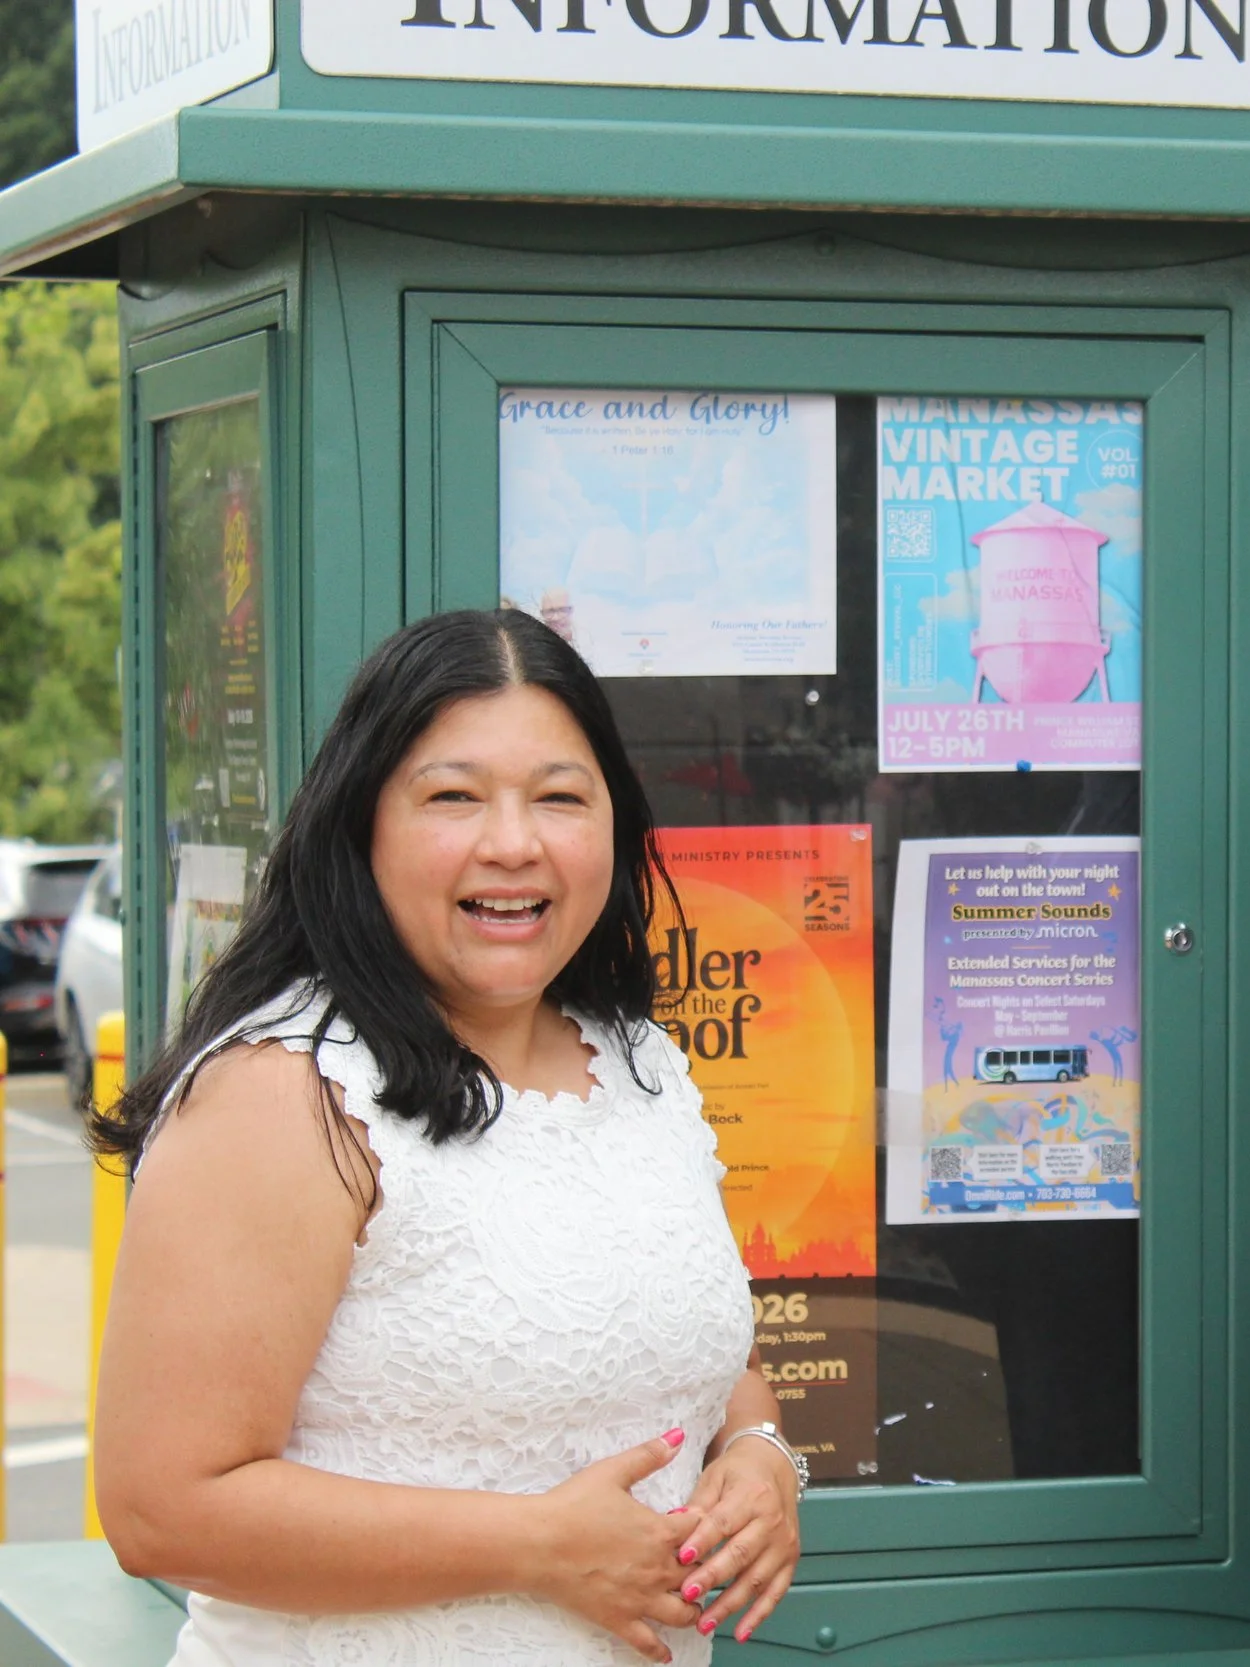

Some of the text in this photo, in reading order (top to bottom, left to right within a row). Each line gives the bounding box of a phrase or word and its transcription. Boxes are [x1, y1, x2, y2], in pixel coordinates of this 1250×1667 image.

[401, 0, 1246, 63] MATION
[500, 392, 790, 435] Grace and Glory!
[883, 399, 1143, 424] MANASSAS
[883, 428, 1079, 463] VINTAGE
[1101, 464, 1136, 479] #01
[883, 467, 1070, 501] MARKET
[888, 709, 1025, 732] JULY 26TH
[888, 737, 985, 759] 12-5PM
[672, 851, 740, 862] MINISTRY
[747, 849, 820, 861] PRESENTS
[945, 864, 1120, 883] Let us help with your night
[976, 883, 1085, 898] out on the town!
[952, 902, 1112, 921] Summer Sounds
[805, 923, 850, 932] SEASONS
[963, 923, 1099, 941] presented by micron
[651, 927, 761, 991] dler
[948, 954, 1116, 971] Extended Services for the
[950, 972, 1113, 988] Manassas Concert Series
[693, 993, 727, 1015] the
[957, 996, 990, 1008] Concert
[1064, 995, 1105, 1008] Saturdays
[995, 1011, 1014, 1023] May
[1022, 1010, 1068, 1023] September
[657, 994, 761, 1061] of
[709, 1113, 744, 1124] Bock
[727, 1164, 740, 1172] old
[756, 1333, 782, 1345] day,
